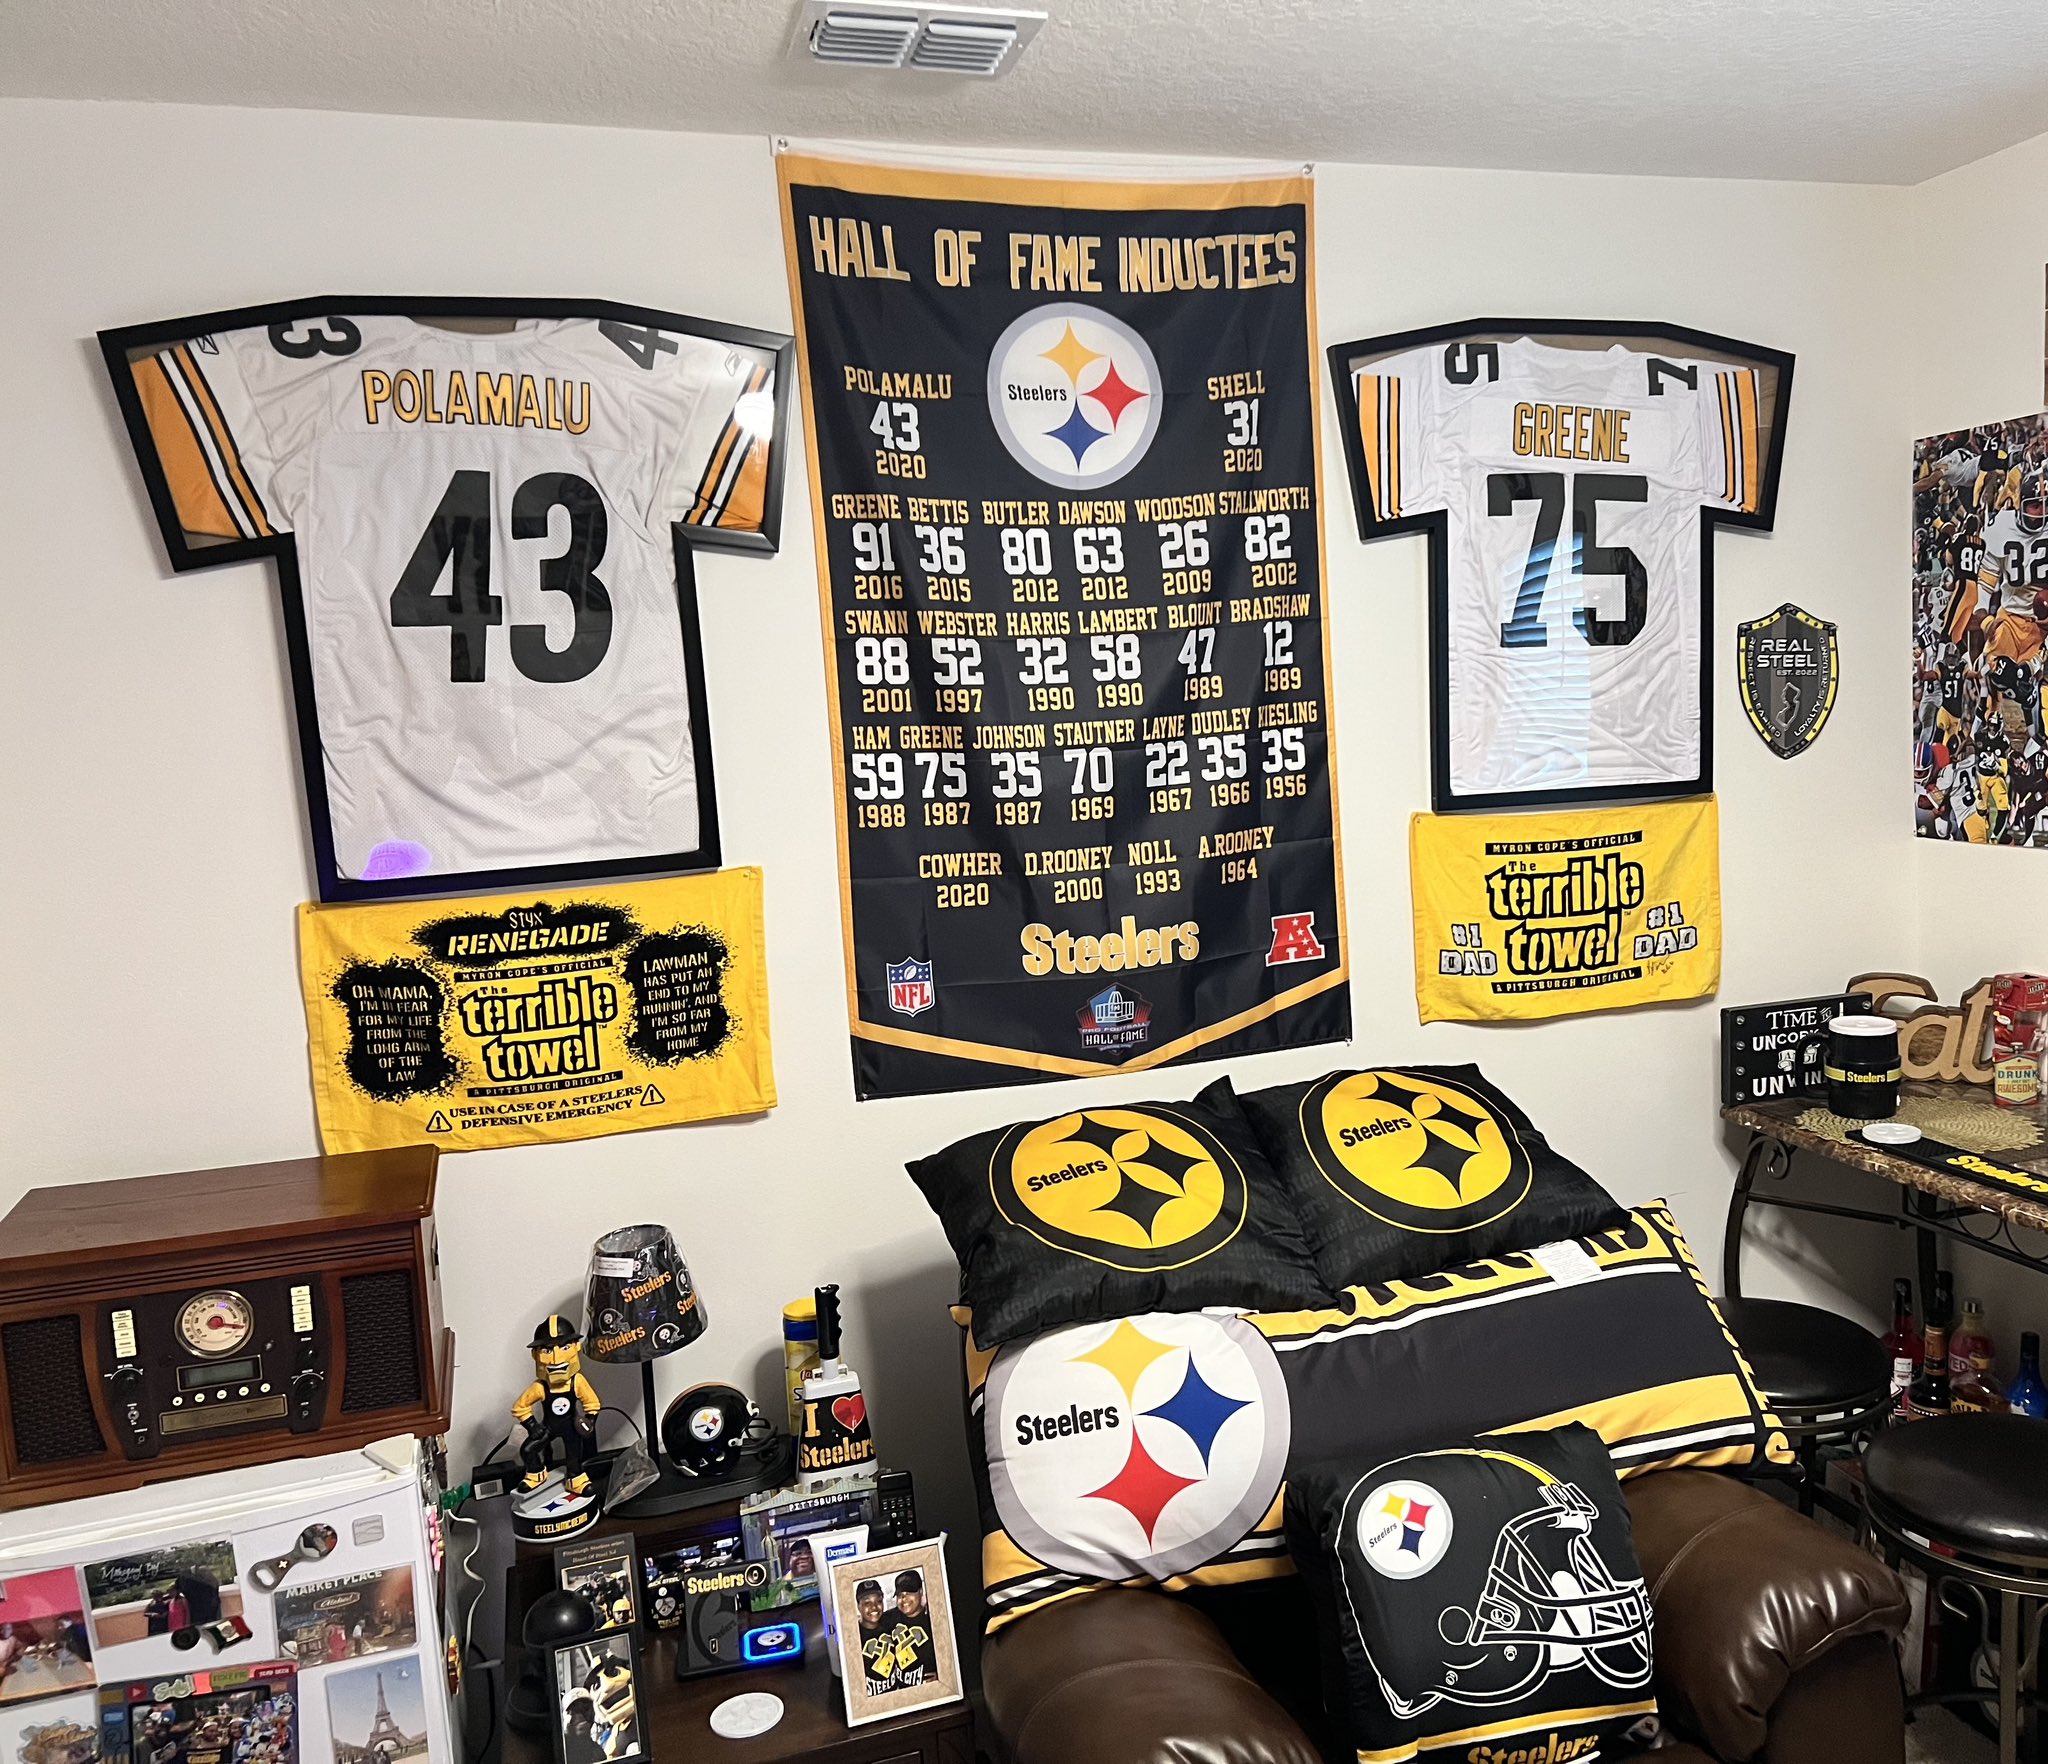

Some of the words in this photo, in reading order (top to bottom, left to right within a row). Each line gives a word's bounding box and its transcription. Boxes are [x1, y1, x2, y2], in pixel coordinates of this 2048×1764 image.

[809, 215, 910, 281] HALL
[934, 228, 981, 287] OF
[1009, 233, 1101, 291] FAME
[1119, 231, 1296, 292] INDUCTEES
[845, 366, 951, 399] POLAMALU
[1207, 371, 1265, 400] SHELL
[1008, 384, 1066, 402] Steelers
[362, 369, 591, 435] POLAMALU
[870, 402, 920, 451] 43
[1224, 399, 1259, 446] 31
[1513, 401, 1631, 463] GREENE
[877, 451, 926, 479] 2020
[1224, 449, 1262, 472] 2020
[832, 493, 900, 519] GREENE
[908, 497, 969, 524] BETTIS
[982, 500, 1050, 525] BUTLER
[1058, 500, 1126, 524] DAWSON
[1135, 493, 1215, 522] WOODSON
[1219, 488, 1309, 514] STALLWORTH
[853, 523, 895, 571] 91
[915, 526, 965, 574] 36
[1002, 528, 1052, 575] 80
[1073, 527, 1124, 573] 63
[1159, 520, 1209, 569] 26
[1244, 515, 1292, 561] 82
[1487, 472, 1648, 648] 75
[390, 469, 613, 683] 43
[855, 575, 902, 599] 2016
[927, 577, 971, 601] 2015
[1012, 578, 1059, 602] 2012
[1081, 576, 1128, 600] 2012
[1163, 570, 1211, 595] 2009
[1252, 563, 1297, 587] 2002
[846, 611, 908, 635] SWANN
[917, 611, 997, 637] WEBSTER
[1007, 612, 1070, 636] HARRIS
[1078, 607, 1158, 634] LAMBERT
[1168, 602, 1221, 629] BLOUNT
[1231, 595, 1310, 622] BRADSHAW
[855, 637, 909, 685] 88
[931, 638, 984, 685] 52
[1017, 637, 1068, 684] 32
[1090, 634, 1142, 680] 58
[1178, 628, 1217, 674] 47
[1263, 620, 1293, 666] 12
[1761, 638, 1814, 652] REAL
[1757, 654, 1817, 667] STEEL
[863, 689, 912, 712] 2001
[935, 689, 982, 712] 1997
[1028, 688, 1074, 711] 1990
[1096, 683, 1143, 707] 1990
[1184, 676, 1223, 701] 1989
[1264, 668, 1301, 692] 1989
[1944, 681, 1958, 698] 51
[852, 726, 890, 750] HAM
[900, 726, 963, 750] GREENE
[972, 724, 1045, 749] JOHNSON
[1053, 720, 1135, 747] STAUTNER
[1142, 715, 1184, 739] LAYNE
[1192, 708, 1250, 734] DUDLEY
[1258, 702, 1317, 728] KIESLING
[1794, 701, 1822, 737] LOYALTY
[852, 753, 903, 800] 59
[915, 752, 967, 798] 75
[992, 751, 1042, 798] 35
[1064, 747, 1113, 794] 70
[1146, 740, 1190, 786] 22
[1198, 734, 1247, 781] 35
[1262, 726, 1306, 773] 35
[858, 804, 905, 828] 1988
[924, 803, 970, 826] 1987
[995, 802, 1042, 826] 1987
[1071, 796, 1114, 821] 1969
[1149, 788, 1192, 813] 1967
[1210, 781, 1250, 807] 1966
[1266, 775, 1306, 799] 1956
[919, 853, 1002, 879] COWHER
[1025, 847, 1113, 877] D.ROONEY
[1128, 841, 1176, 867] NOLL
[1199, 826, 1274, 858] A.ROONEY
[1493, 842, 1531, 853] MYRON
[1538, 840, 1577, 852] COPE'S
[1584, 834, 1635, 848] OFFICIAL
[1509, 861, 1536, 872] The
[937, 883, 988, 908] 2020
[1055, 878, 1103, 904] 2000
[1135, 869, 1181, 895] 1993
[1221, 860, 1258, 884] 1964
[1485, 853, 1644, 920] terrible
[1647, 902, 1683, 929] #1
[448, 922, 609, 956] RENEGADE
[1020, 915, 1199, 976] Steelers
[1451, 923, 1482, 948] #1
[1505, 910, 1622, 975] towel
[1634, 927, 1697, 960] DAD
[462, 971, 501, 980] MYRON
[508, 967, 548, 978] COPE'S
[554, 960, 605, 972] OFFICIAL
[644, 952, 708, 973] LAWMAN
[1439, 949, 1497, 975] DAD
[352, 985, 374, 998] OH
[480, 986, 507, 995] The
[644, 975, 667, 987] HAS
[671, 971, 693, 983] PUT
[648, 989, 670, 1001] END
[674, 985, 689, 996] TO
[693, 981, 709, 993] MY
[1507, 978, 1576, 991] PITTSBURGH
[1583, 970, 1634, 986] ORIGINAL
[397, 1001, 428, 1012] FEAR
[458, 975, 618, 1037] terrible
[695, 994, 717, 1006] AND
[892, 982, 930, 1009] NFL
[358, 1015, 382, 1026] FOR
[409, 1015, 432, 1025] LIFE
[691, 1008, 711, 1019] FAR
[1766, 1007, 1817, 1030] TIME
[367, 1029, 402, 1040] FROM
[656, 1025, 687, 1040] FROM
[667, 1037, 699, 1051] HOME
[1086, 1034, 1113, 1045] HALL
[1120, 1029, 1144, 1042] FAME
[367, 1043, 399, 1054] LONG
[405, 1042, 430, 1052] ARM
[399, 1056, 422, 1066] THE
[483, 1022, 599, 1083] towel
[388, 1071, 416, 1082] LAW
[487, 1083, 558, 1095] PITTSBURGH
[565, 1074, 617, 1088] ORIGINAL
[1847, 1071, 1885, 1083] Steelers
[450, 1107, 475, 1117] USE
[480, 1106, 495, 1115] IN
[497, 1103, 534, 1114] CASE
[537, 1101, 555, 1110] OF
[573, 1086, 642, 1106] STEELERS
[462, 1112, 544, 1129] DEFENSIVE
[546, 1099, 633, 1122] EMERGENCY
[1339, 1115, 1413, 1148] Steelers
[1026, 1157, 1109, 1193] Steelers
[621, 1271, 671, 1303] Steelers
[597, 1326, 646, 1354] Steelers
[805, 1402, 821, 1438] I
[1015, 1402, 1121, 1446] Steelers
[789, 1493, 850, 1511] PITTSBURGH
[1369, 1522, 1398, 1549] Steelers
[286, 1579, 341, 1599] MARKET
[346, 1570, 383, 1586] PLACE
[687, 1573, 745, 1595] Steelers
